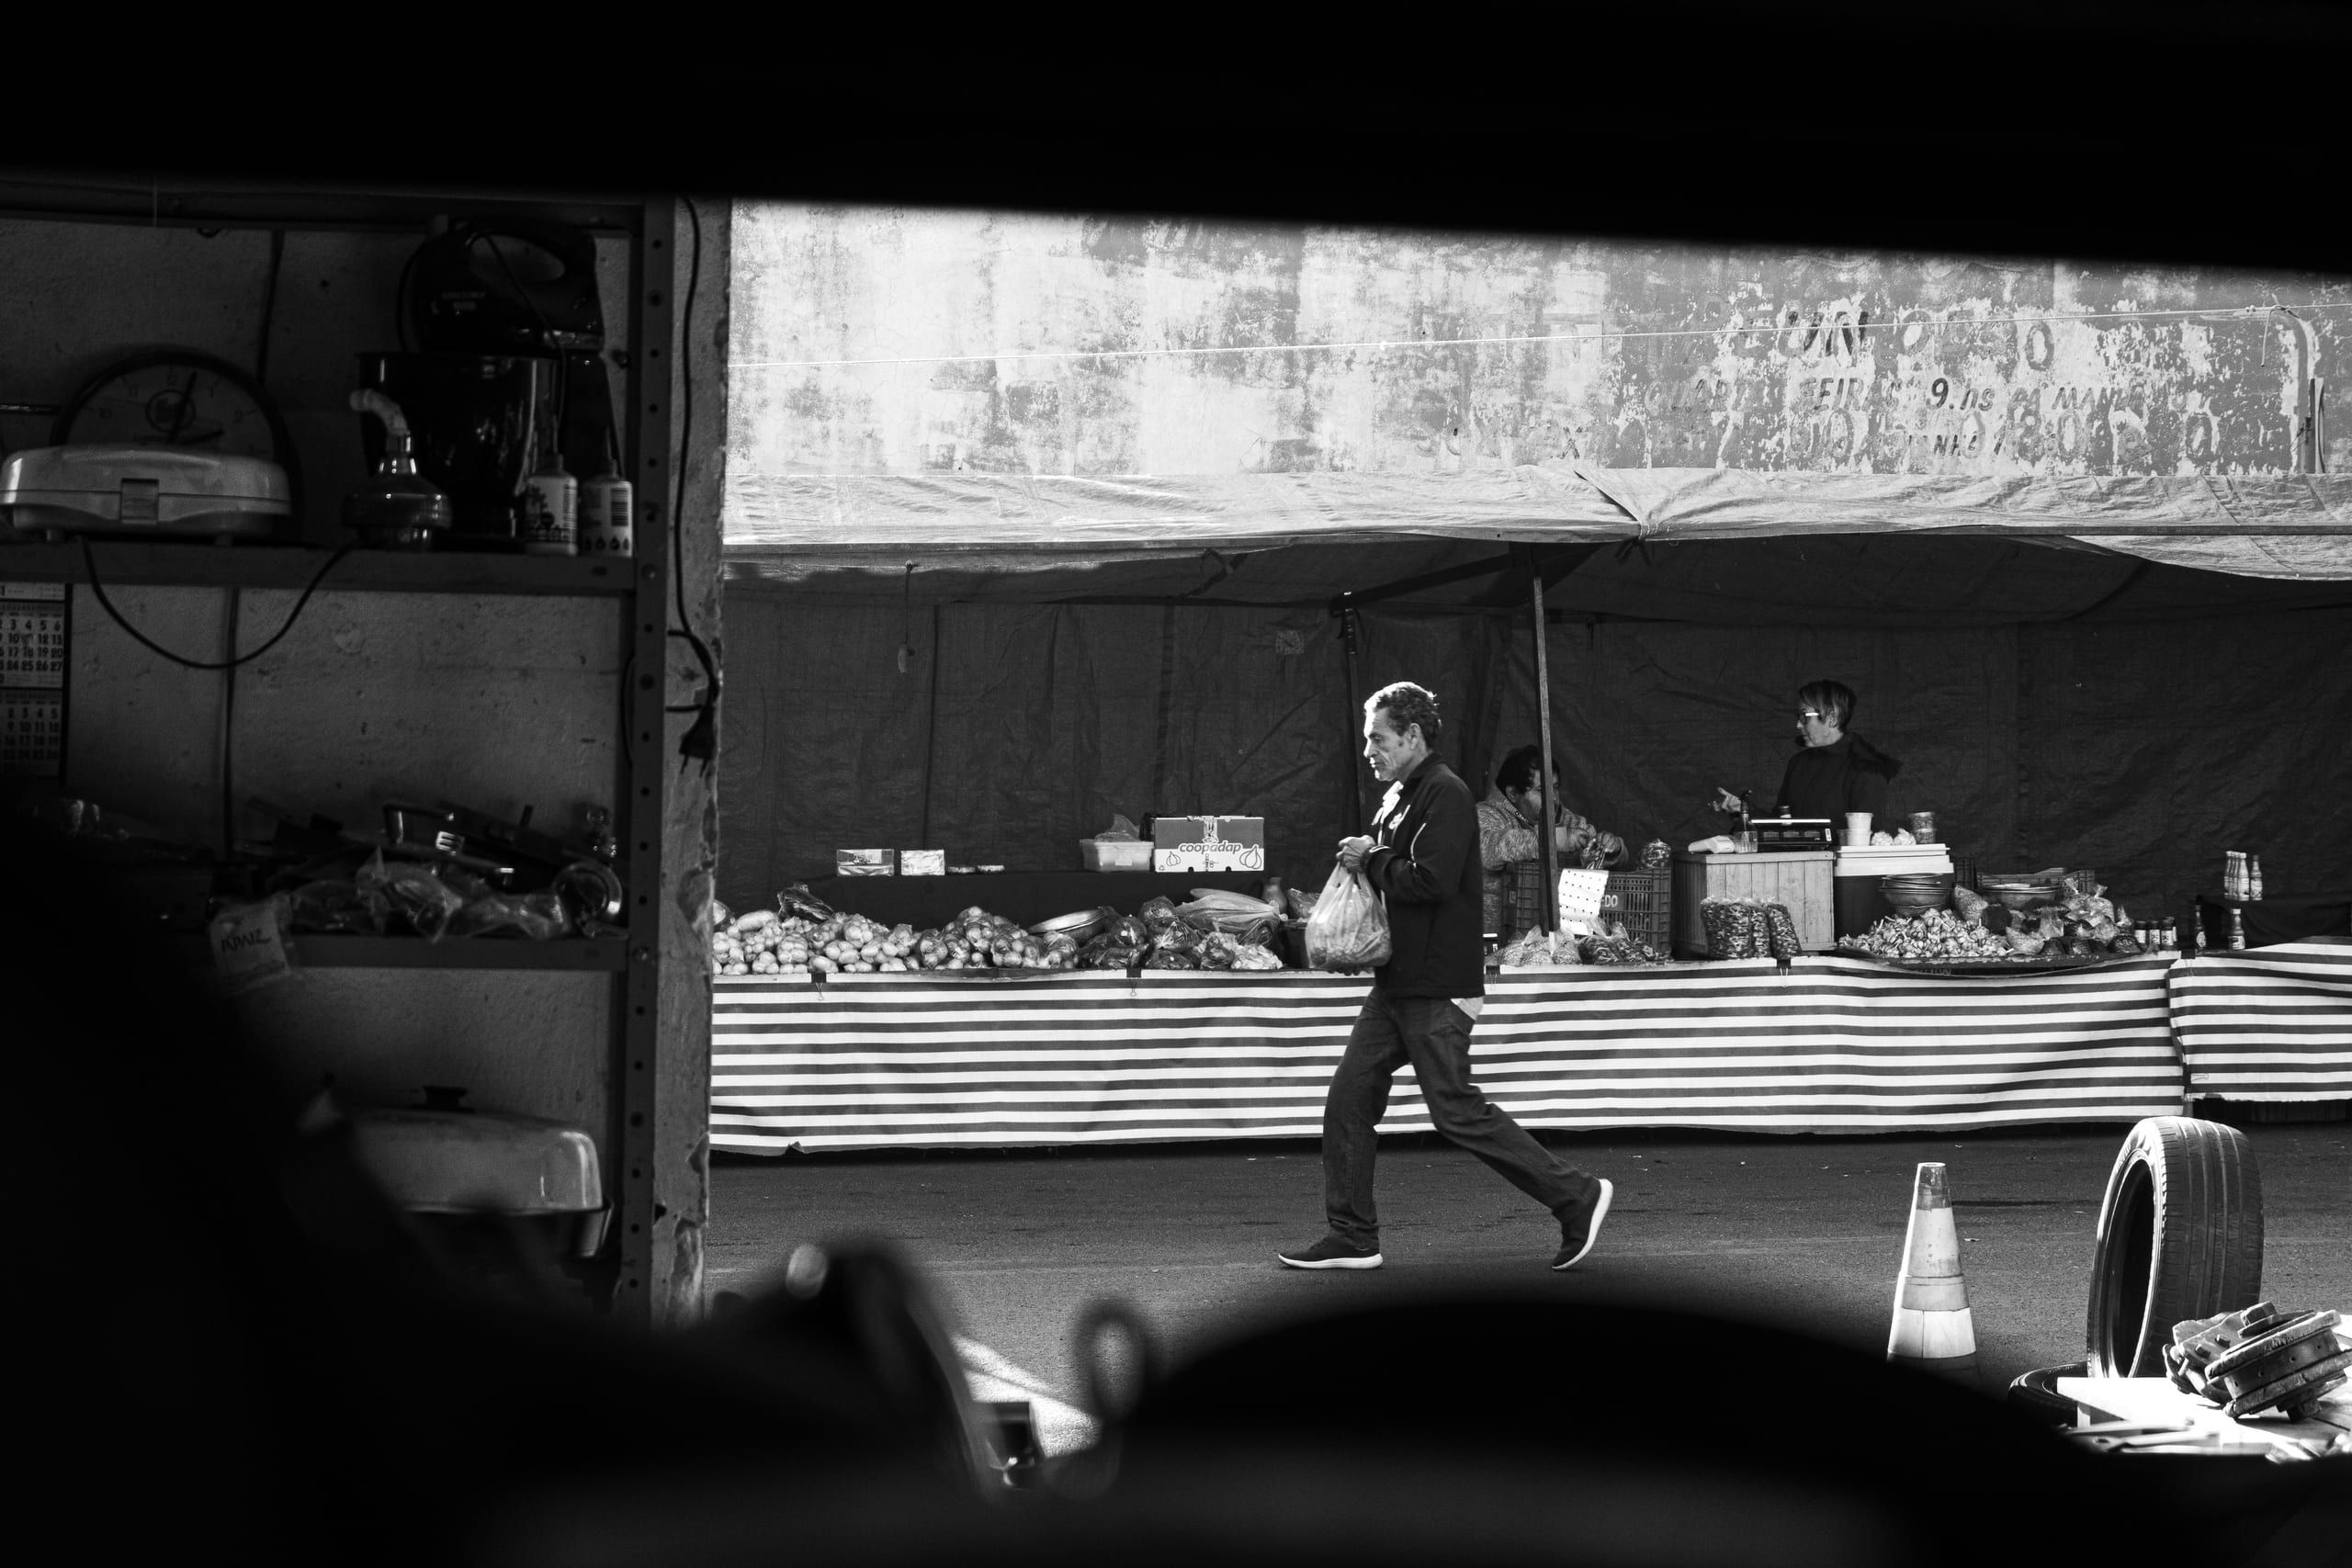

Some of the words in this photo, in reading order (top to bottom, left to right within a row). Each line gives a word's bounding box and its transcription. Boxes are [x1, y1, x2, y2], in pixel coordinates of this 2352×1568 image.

[10, 618, 17, 630] 3
[25, 619, 32, 631] 4
[40, 619, 47, 631] 5
[1179, 841, 1242, 854] coopadap
[1602, 894, 1619, 908] DO
